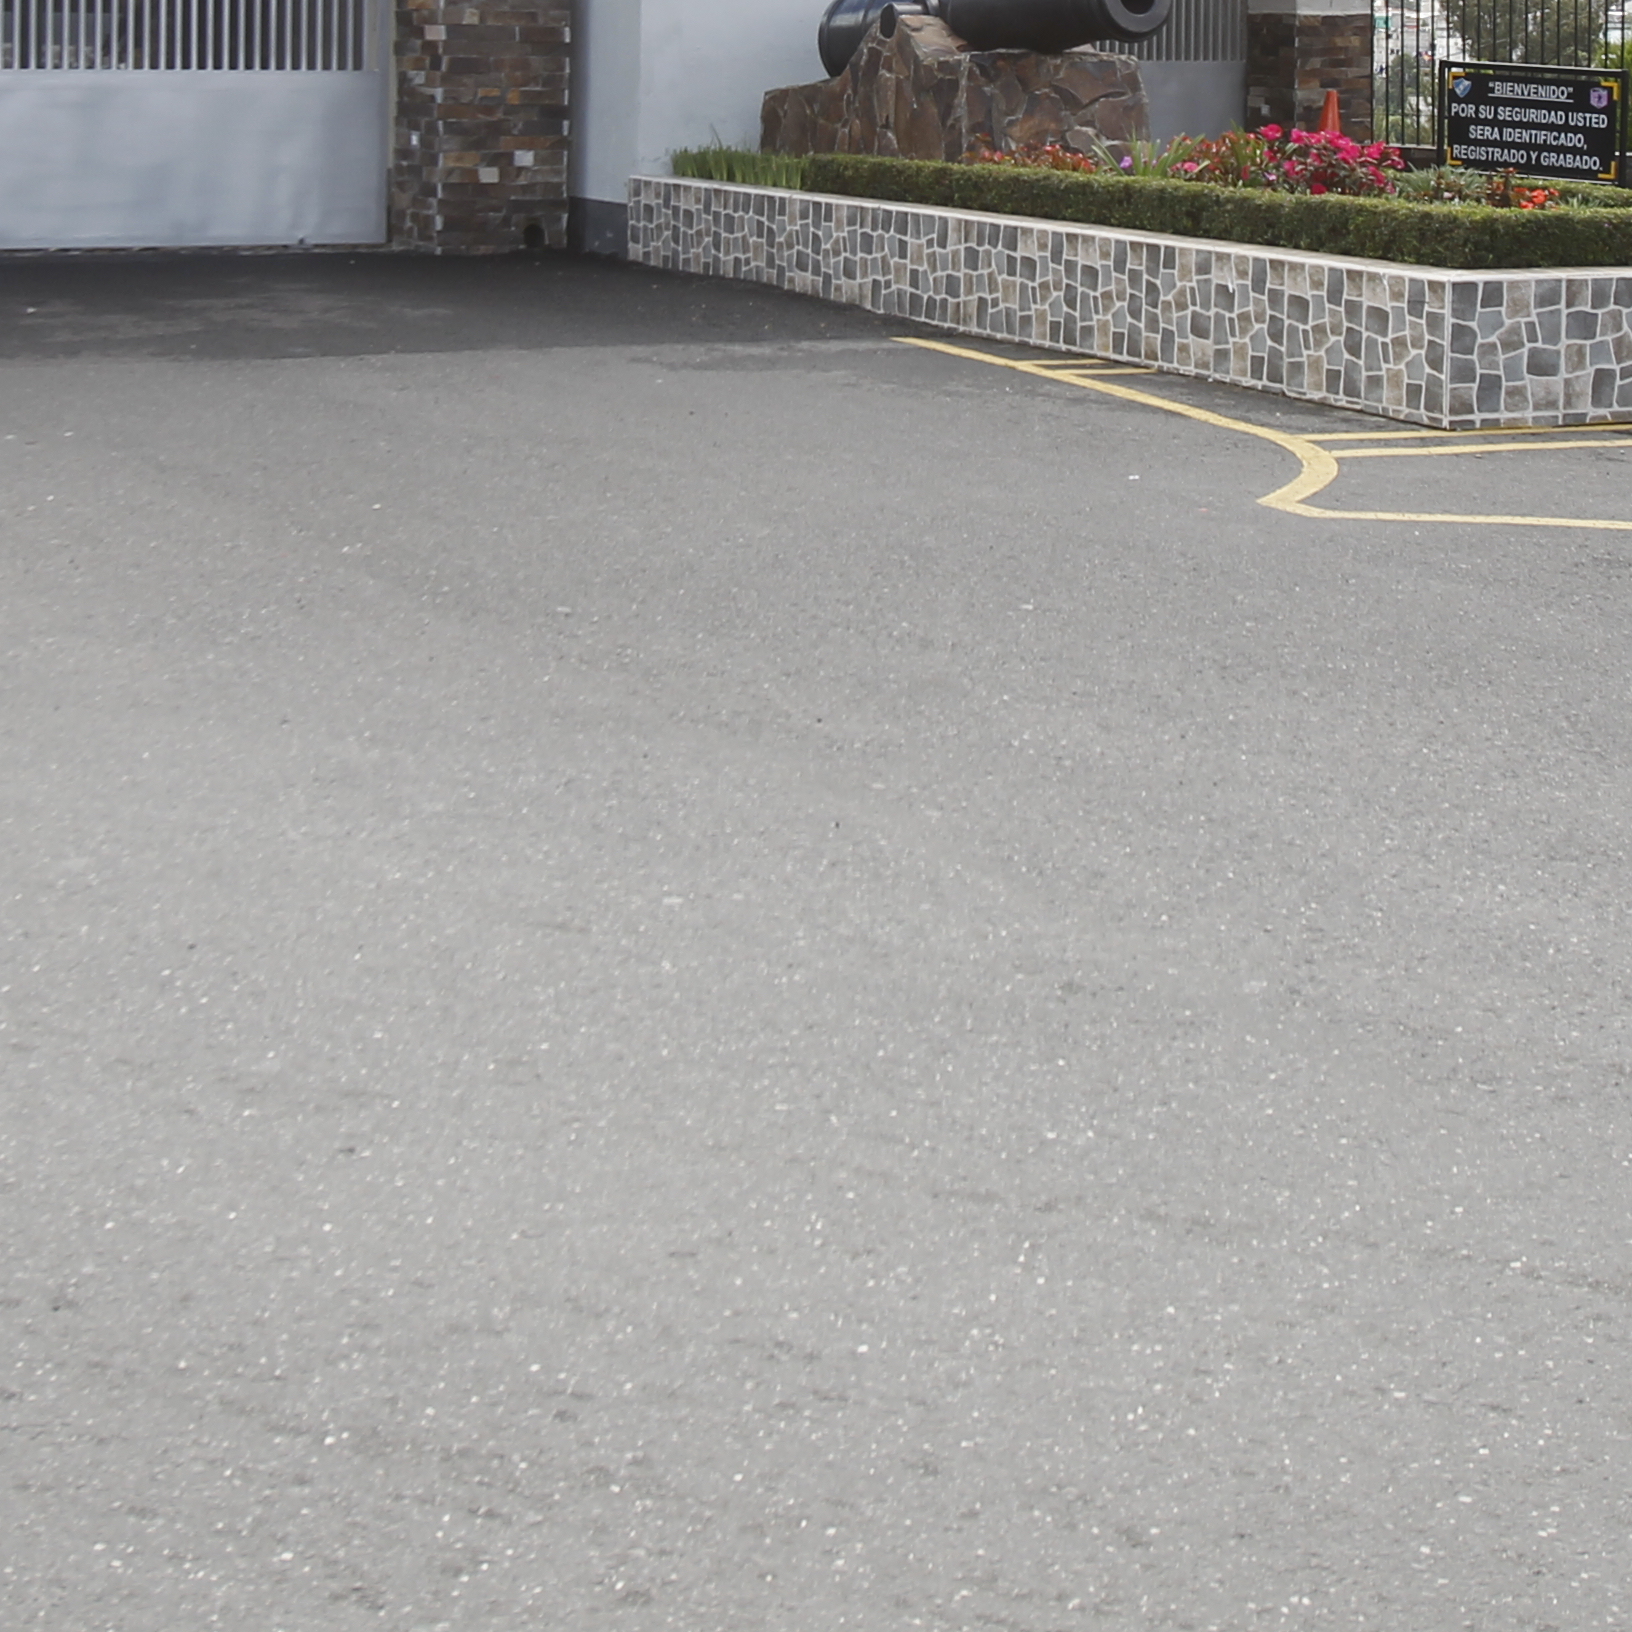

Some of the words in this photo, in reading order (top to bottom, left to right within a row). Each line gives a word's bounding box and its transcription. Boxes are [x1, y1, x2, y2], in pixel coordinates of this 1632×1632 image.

[1451, 103, 1476, 118] POR
[1478, 105, 1494, 120] SU
[1497, 106, 1566, 126] SEGURIDAD
[1568, 112, 1608, 129] USTED
[1469, 125, 1500, 141] SERA
[1502, 128, 1588, 150] IDENTIFICADO,
[1452, 144, 1527, 164] REGISTRADO
[1529, 151, 1539, 165] Y
[1540, 152, 1603, 171] GRABADO.
